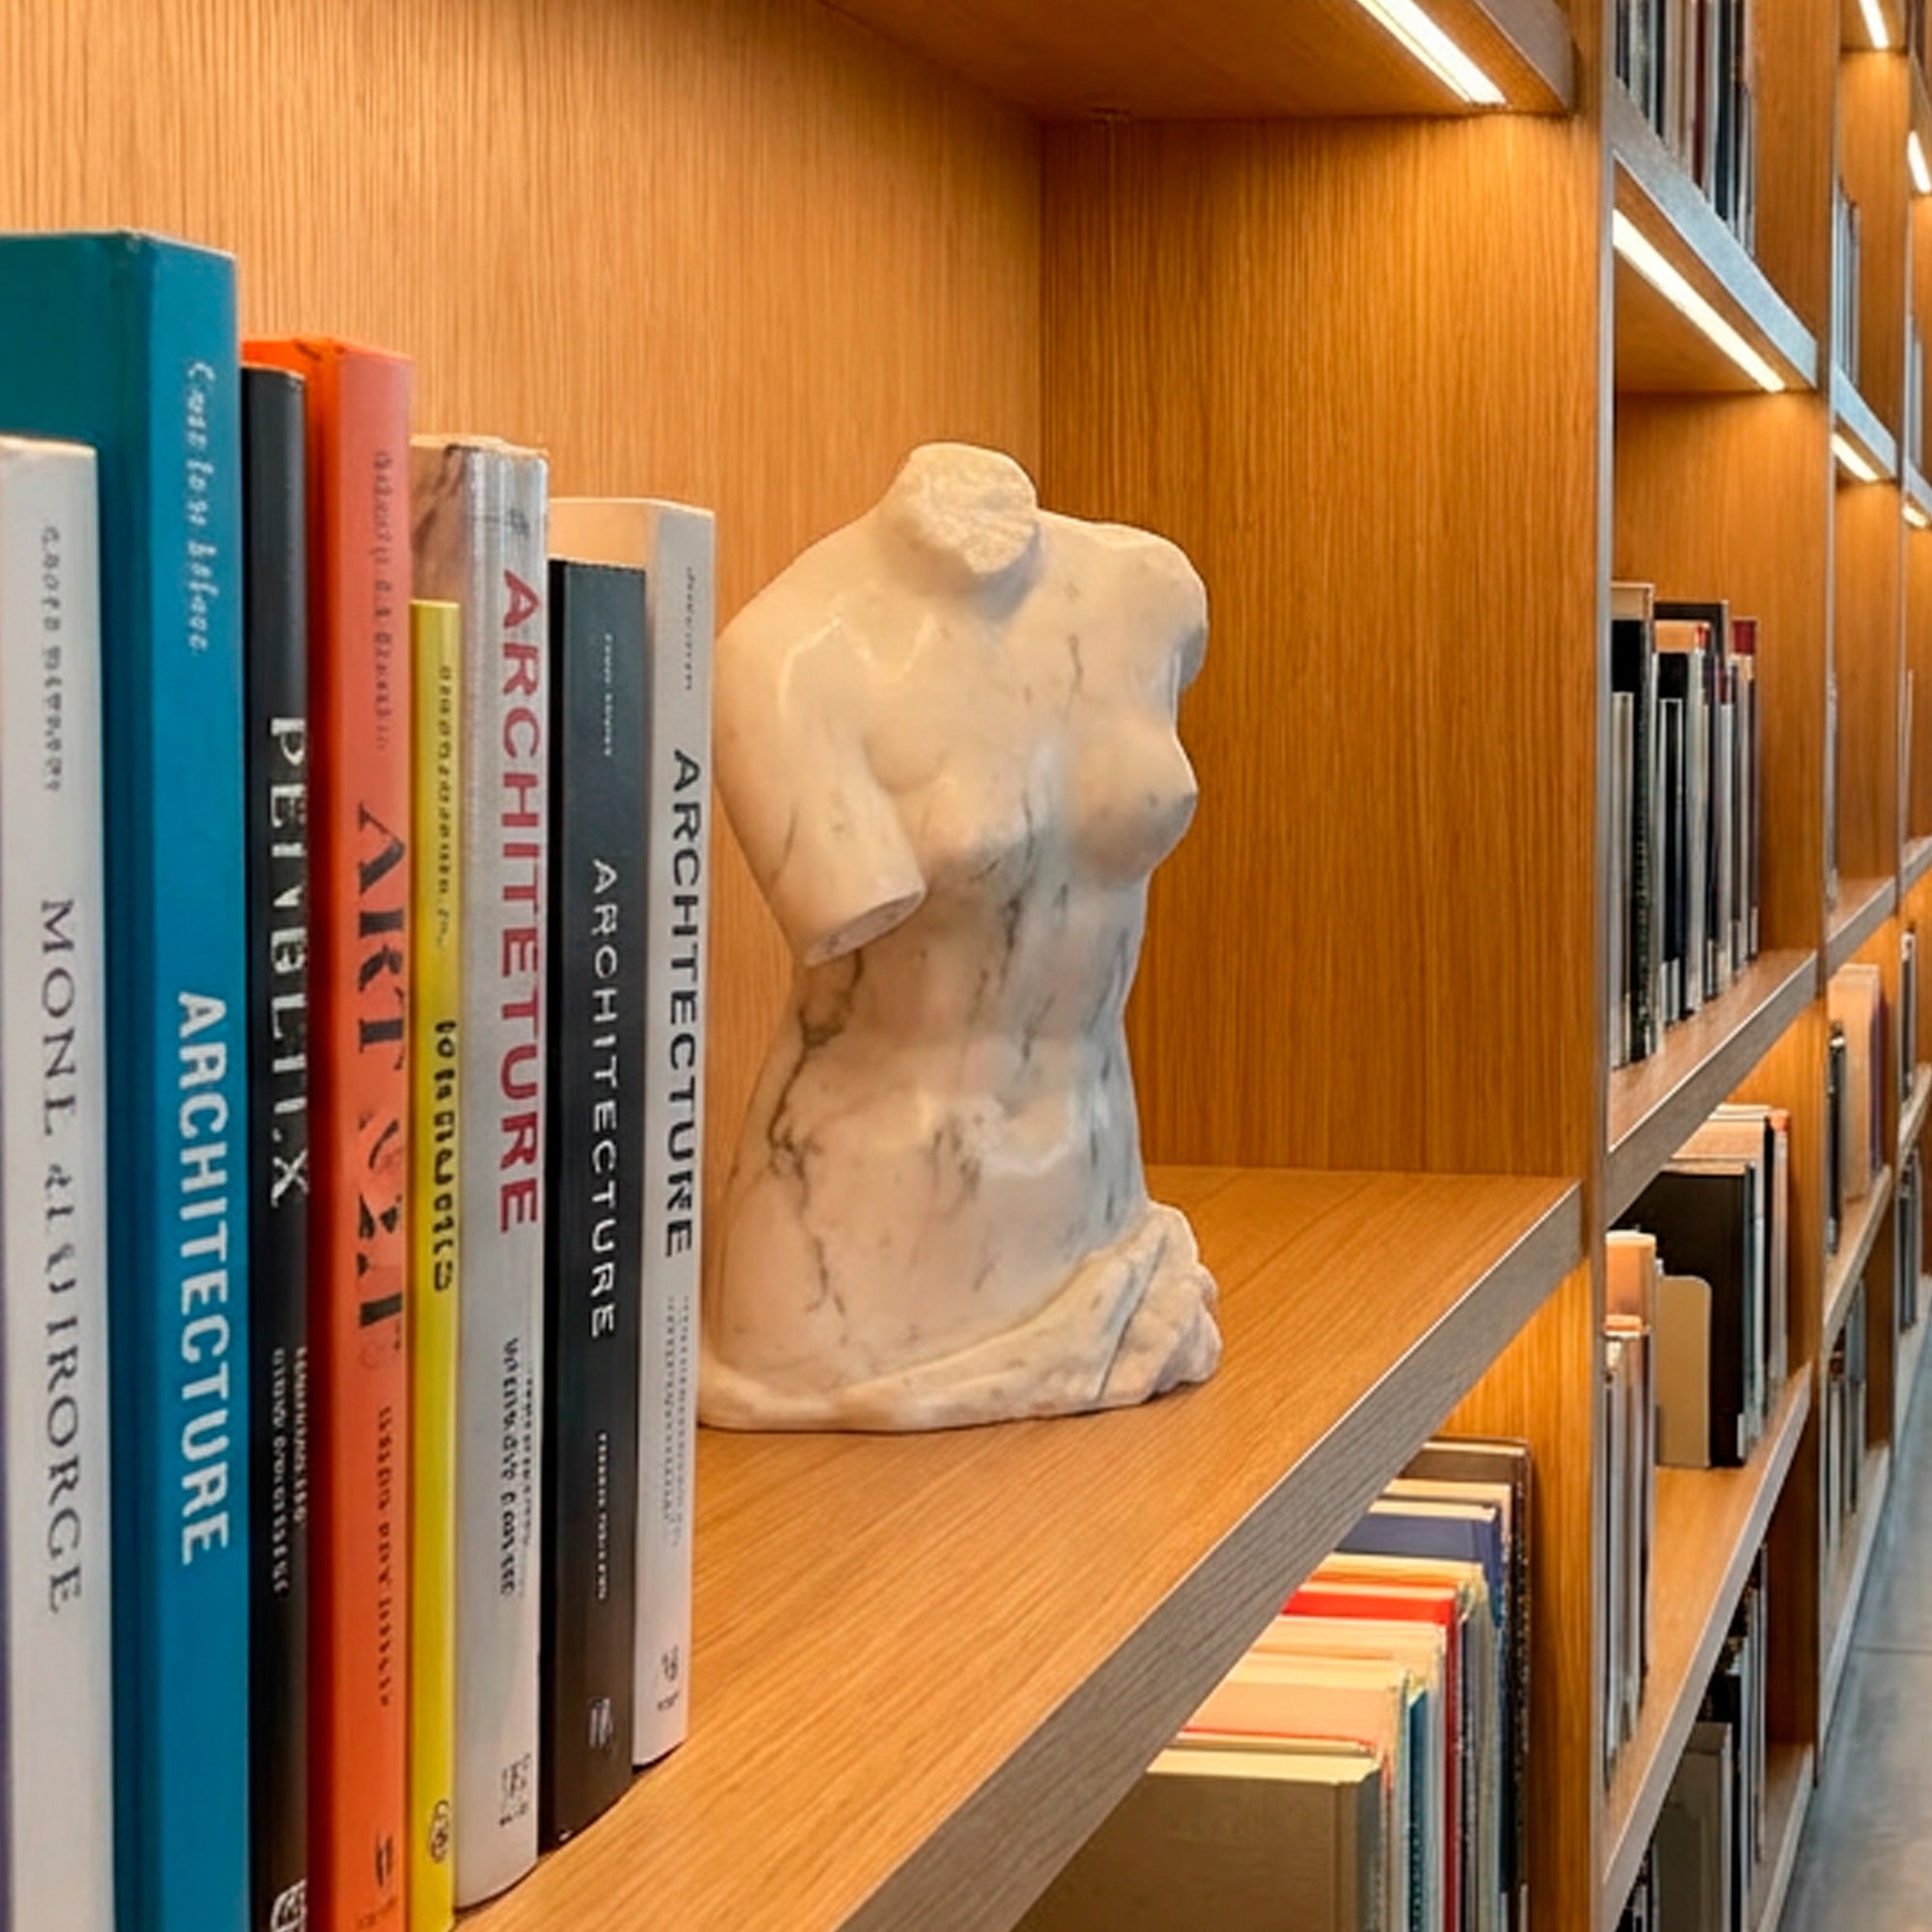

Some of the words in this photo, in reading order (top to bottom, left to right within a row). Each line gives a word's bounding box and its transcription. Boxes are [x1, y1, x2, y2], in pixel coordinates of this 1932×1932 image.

[501, 570, 541, 1235] ARCHITETURE
[590, 858, 618, 1339] ARCHITECTURE
[665, 749, 701, 1259] ARCHTECTURE
[178, 991, 230, 1567] ARCHITECTURE
